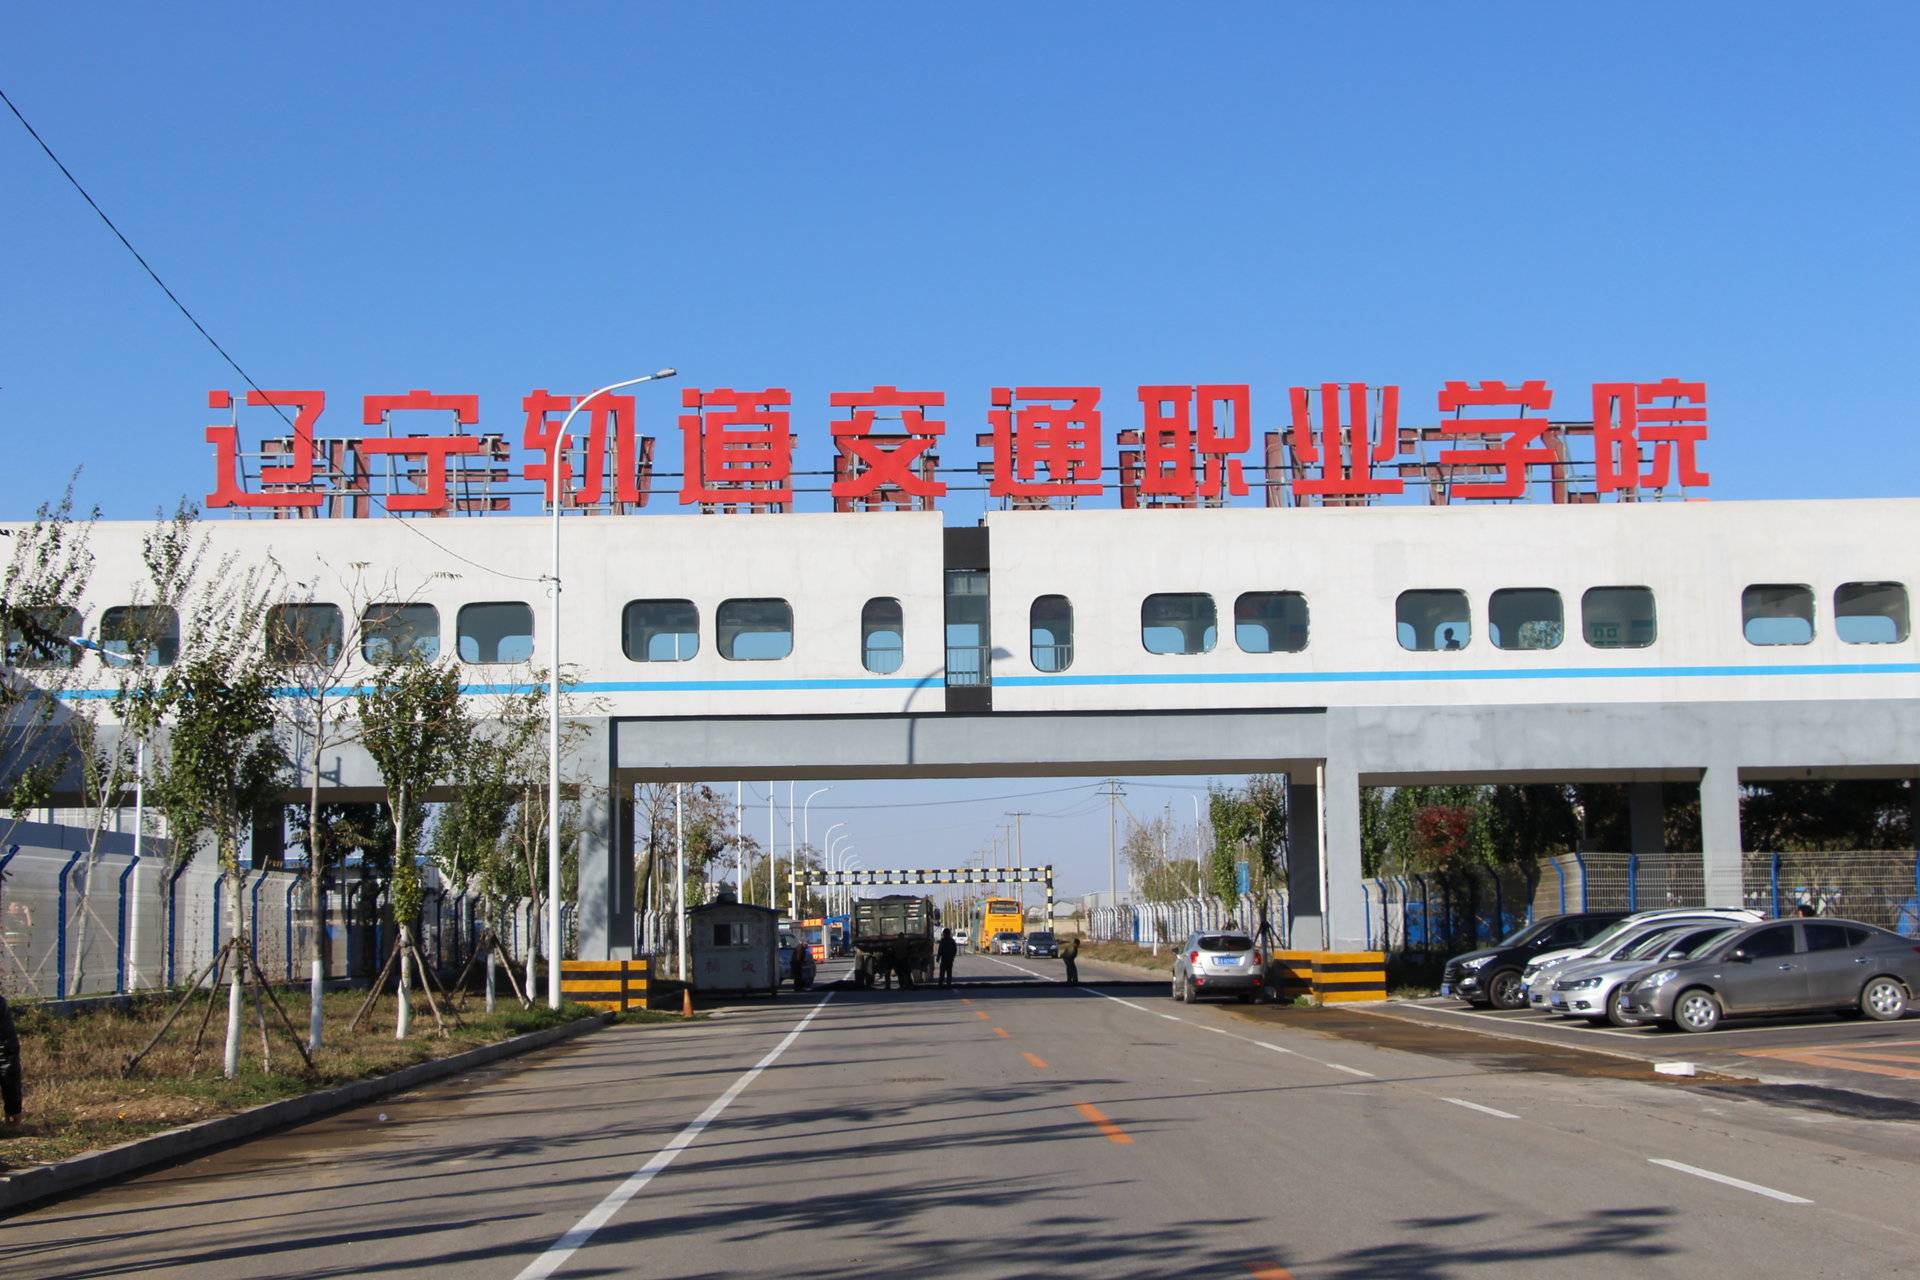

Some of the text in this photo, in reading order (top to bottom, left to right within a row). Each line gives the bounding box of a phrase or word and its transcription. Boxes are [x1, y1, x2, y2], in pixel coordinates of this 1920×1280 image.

[206, 378, 1709, 512] 辽宁轨道交通职业学院
